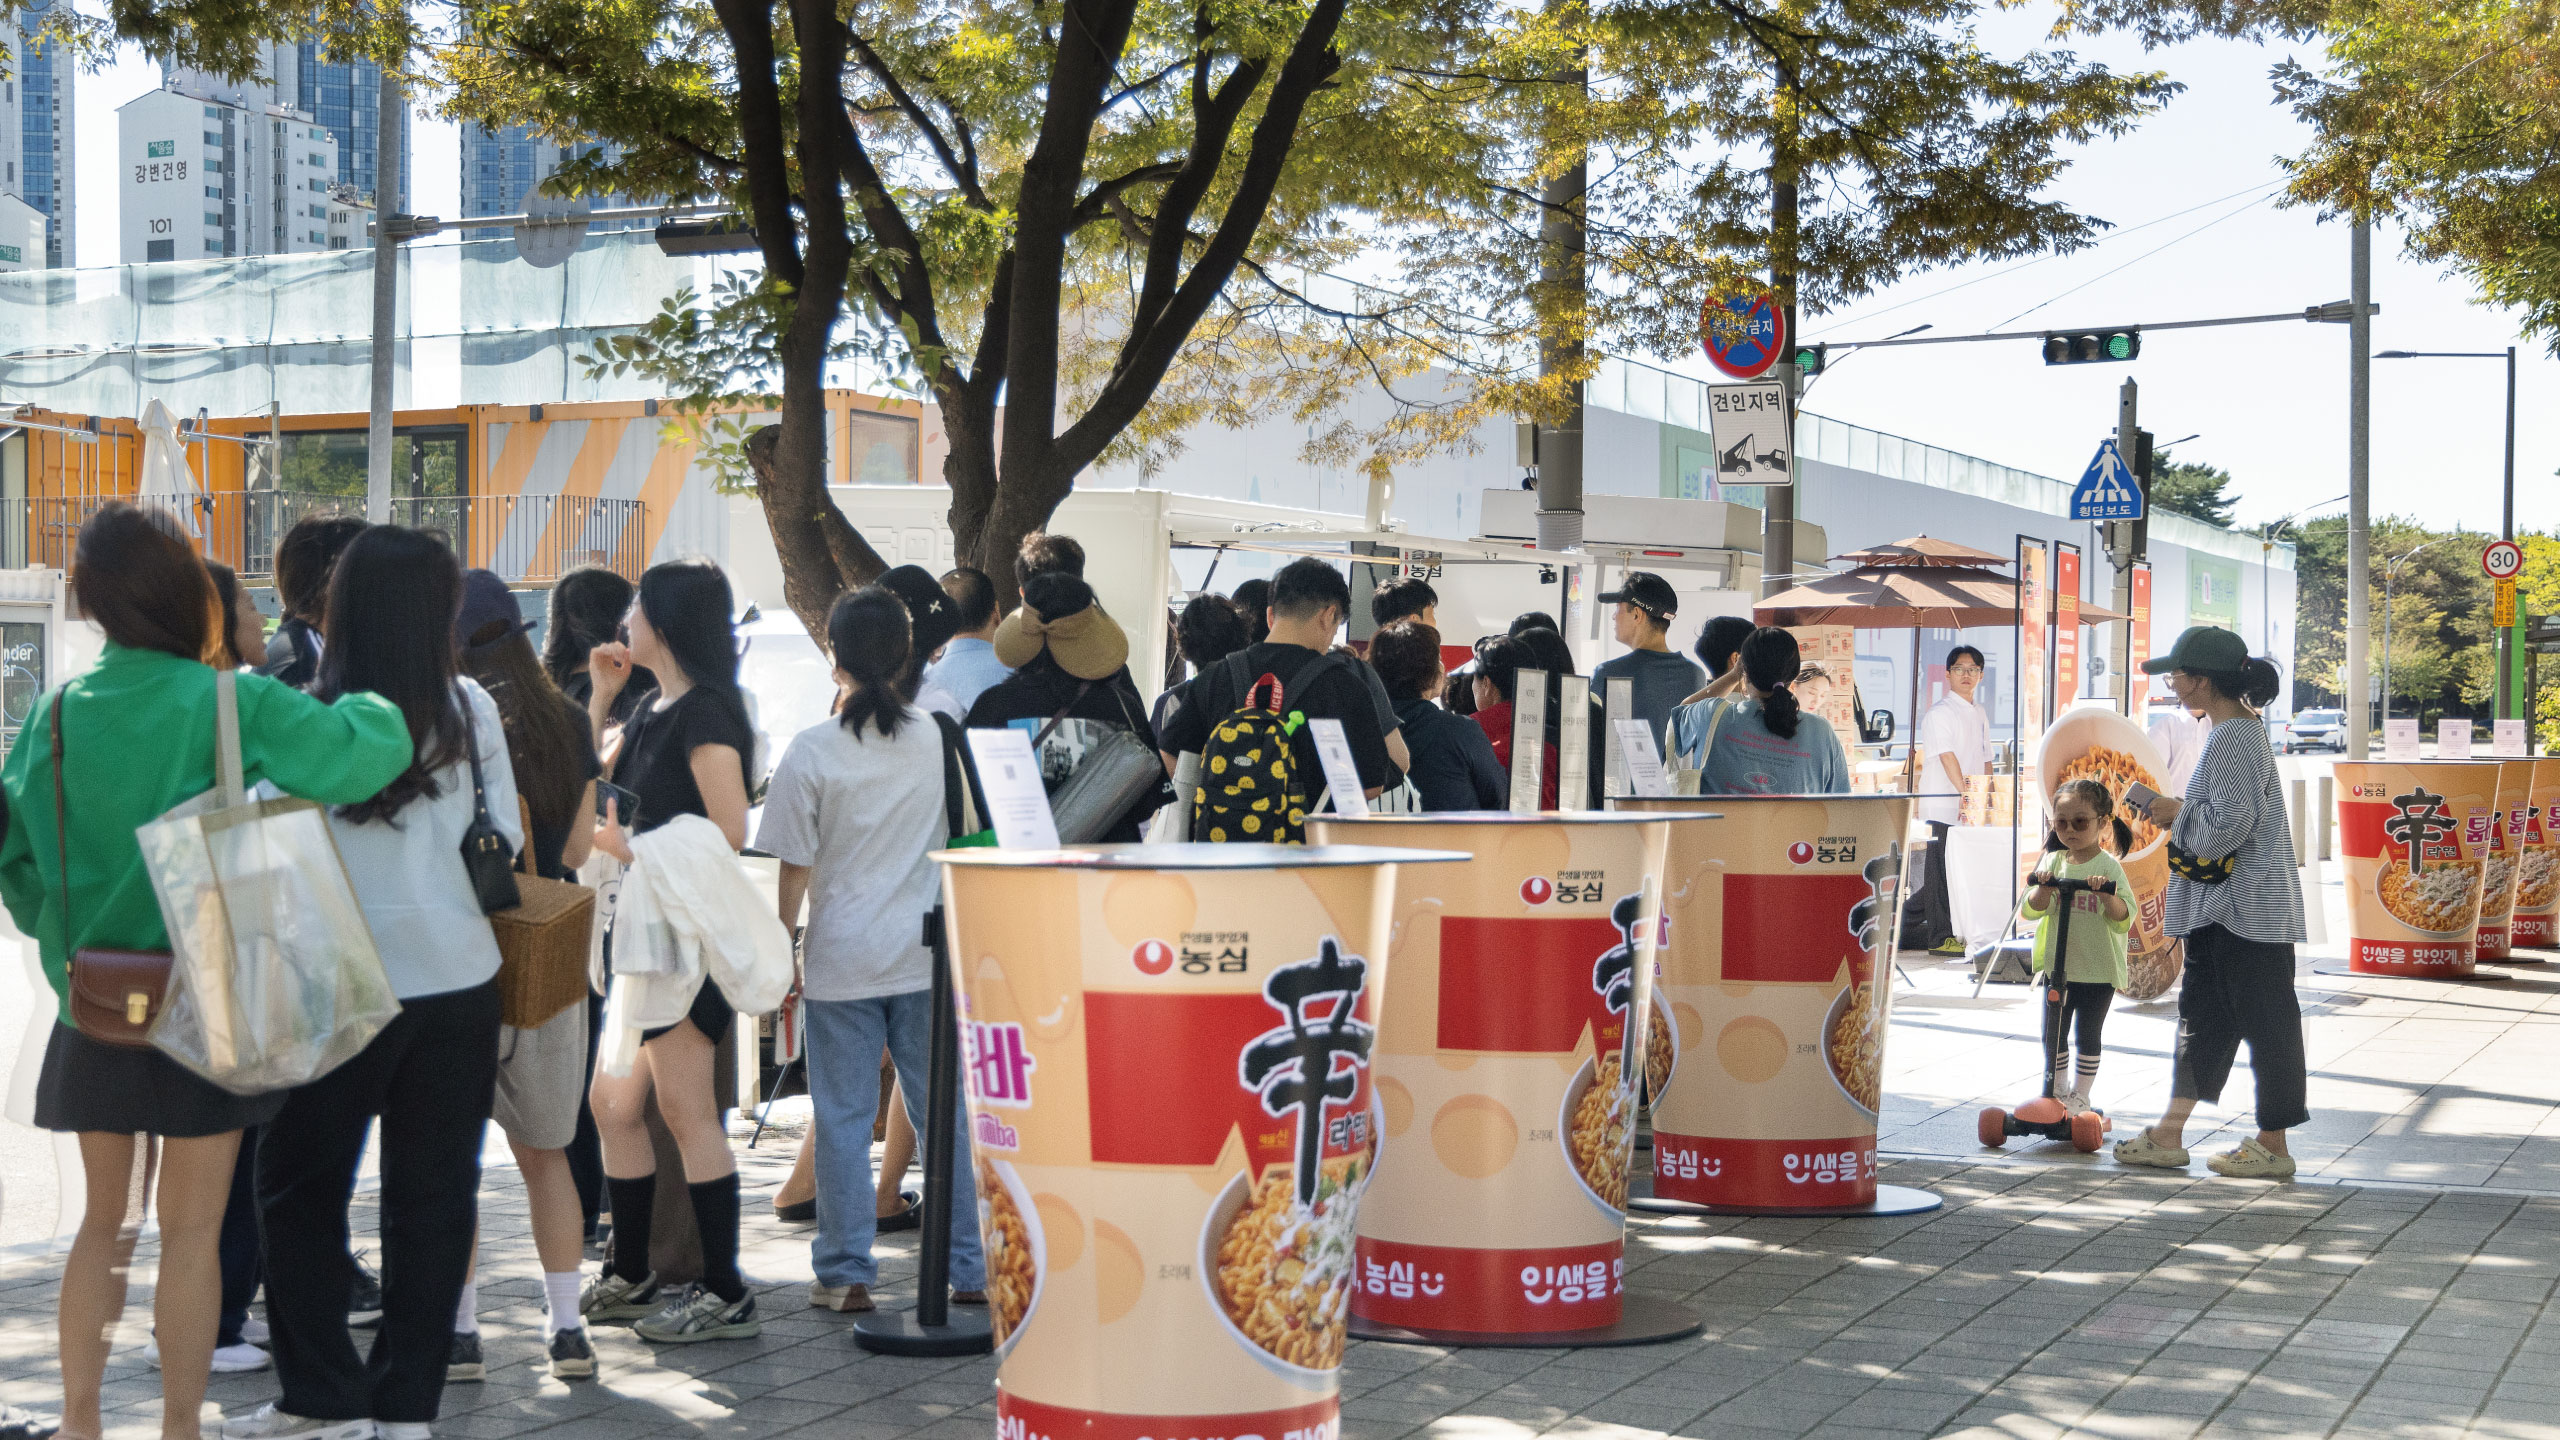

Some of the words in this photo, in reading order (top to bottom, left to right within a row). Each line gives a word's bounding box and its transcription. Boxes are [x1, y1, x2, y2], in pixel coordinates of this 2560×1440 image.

[135, 160, 187, 183] 강변건영
[149, 218, 172, 233] 101
[1713, 391, 1780, 412] 견인지역
[2079, 505, 2132, 516] 횡단보도
[2490, 552, 2515, 568] 30
[2364, 787, 2386, 797] 농심
[2386, 786, 2458, 875] 辛
[1817, 845, 1856, 864] 농심
[2426, 846, 2456, 859] 라면
[1556, 881, 1603, 904] 농심
[1181, 946, 1247, 974] 농심
[2362, 945, 2406, 964] 인생을
[2412, 948, 2462, 966] 맛있게,
[1245, 939, 1375, 1205] 辛
[1662, 1146, 1698, 1180] 농심
[1783, 1150, 1858, 1184] 인생을
[1366, 1255, 1414, 1299] 농심
[1520, 1260, 1607, 1304] 인생을
